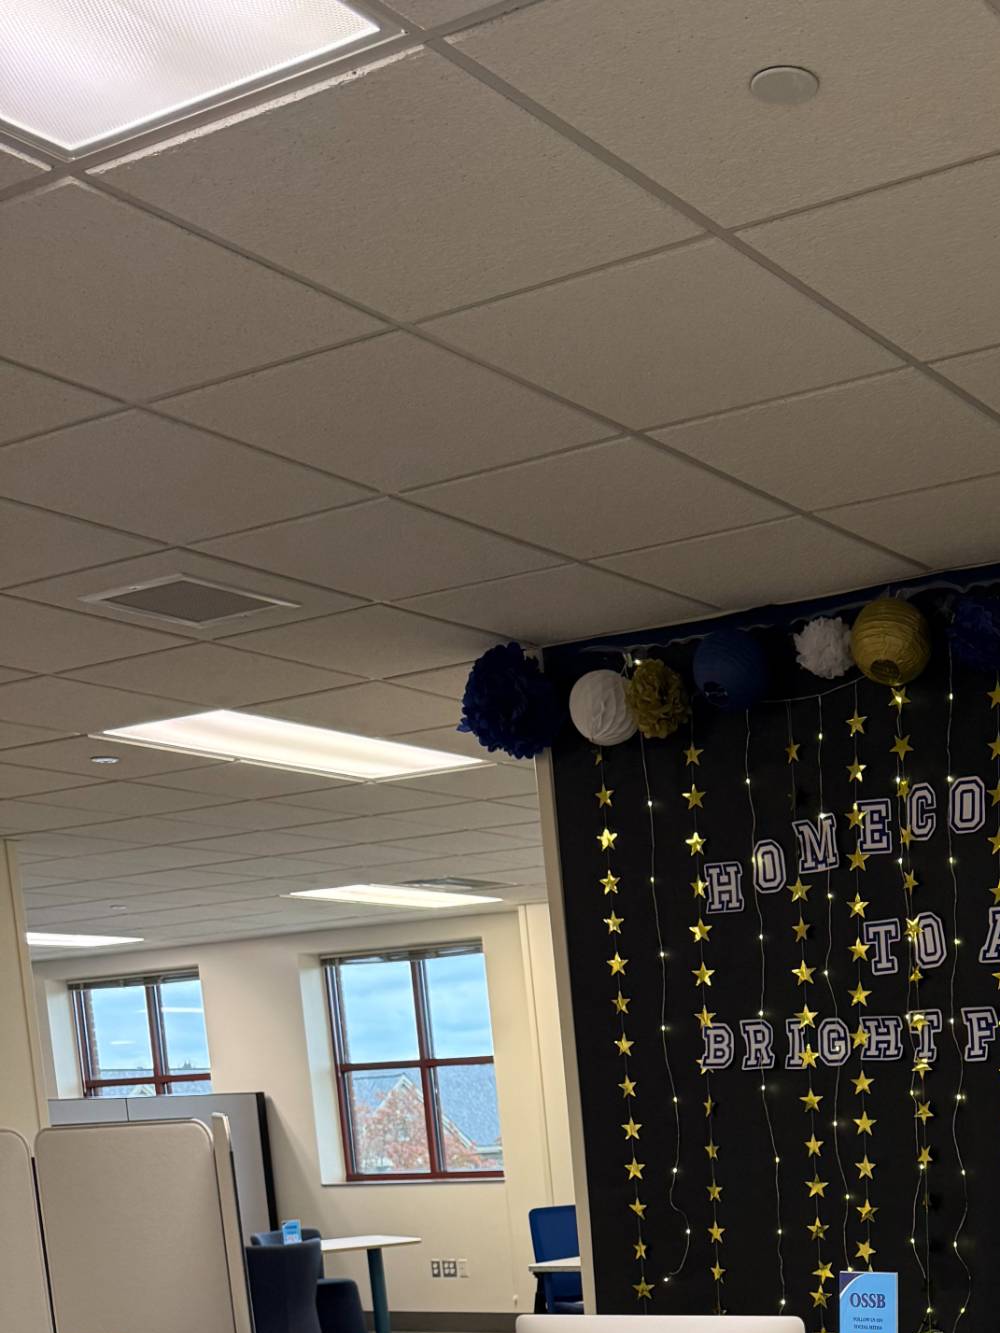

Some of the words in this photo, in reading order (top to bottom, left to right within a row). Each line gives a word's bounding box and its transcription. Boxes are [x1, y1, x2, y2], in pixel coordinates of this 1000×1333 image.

[863, 911, 946, 975] TO
[701, 1008, 943, 1071] BRIGHT
[850, 1292, 886, 1309] OSSB
